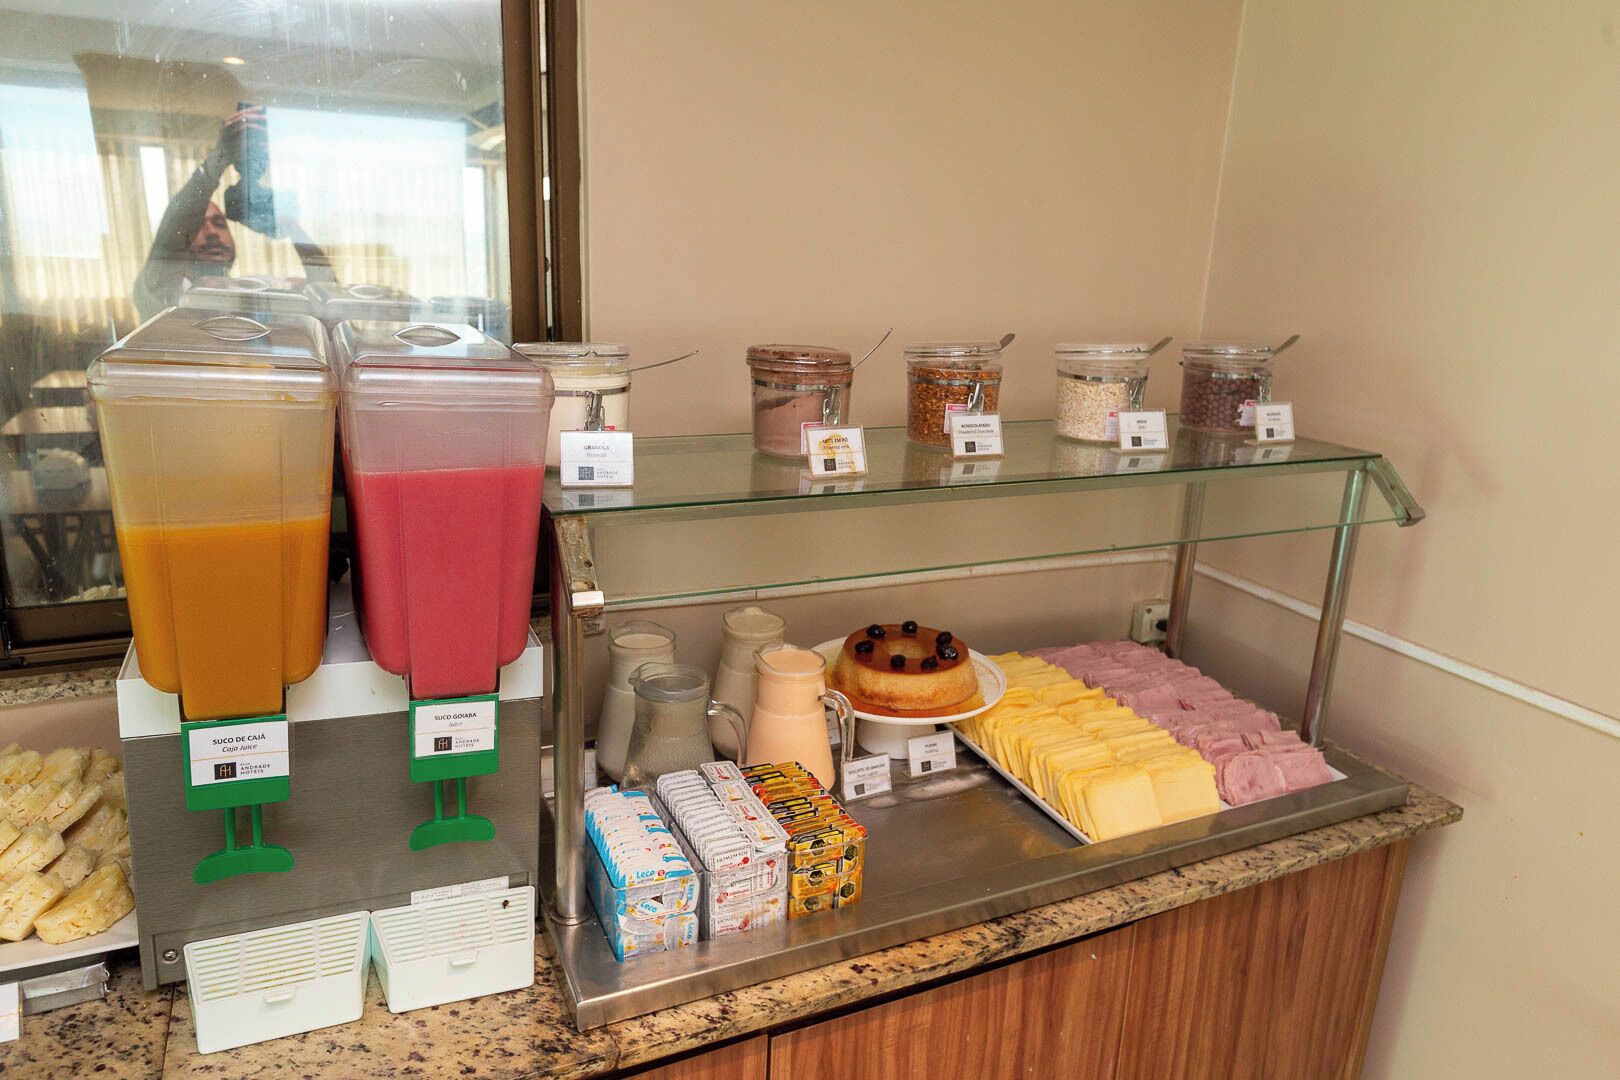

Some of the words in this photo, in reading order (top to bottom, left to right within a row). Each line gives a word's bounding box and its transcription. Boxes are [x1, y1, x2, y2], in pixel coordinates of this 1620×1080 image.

[453, 712, 477, 720] GOIABA
[212, 737, 234, 746] SUCO
[235, 735, 246, 743] DE
[247, 732, 267, 742] CAJÁ
[239, 743, 258, 751] Juice
[240, 763, 271, 771] ANDRADE
[635, 869, 655, 879] Leco
